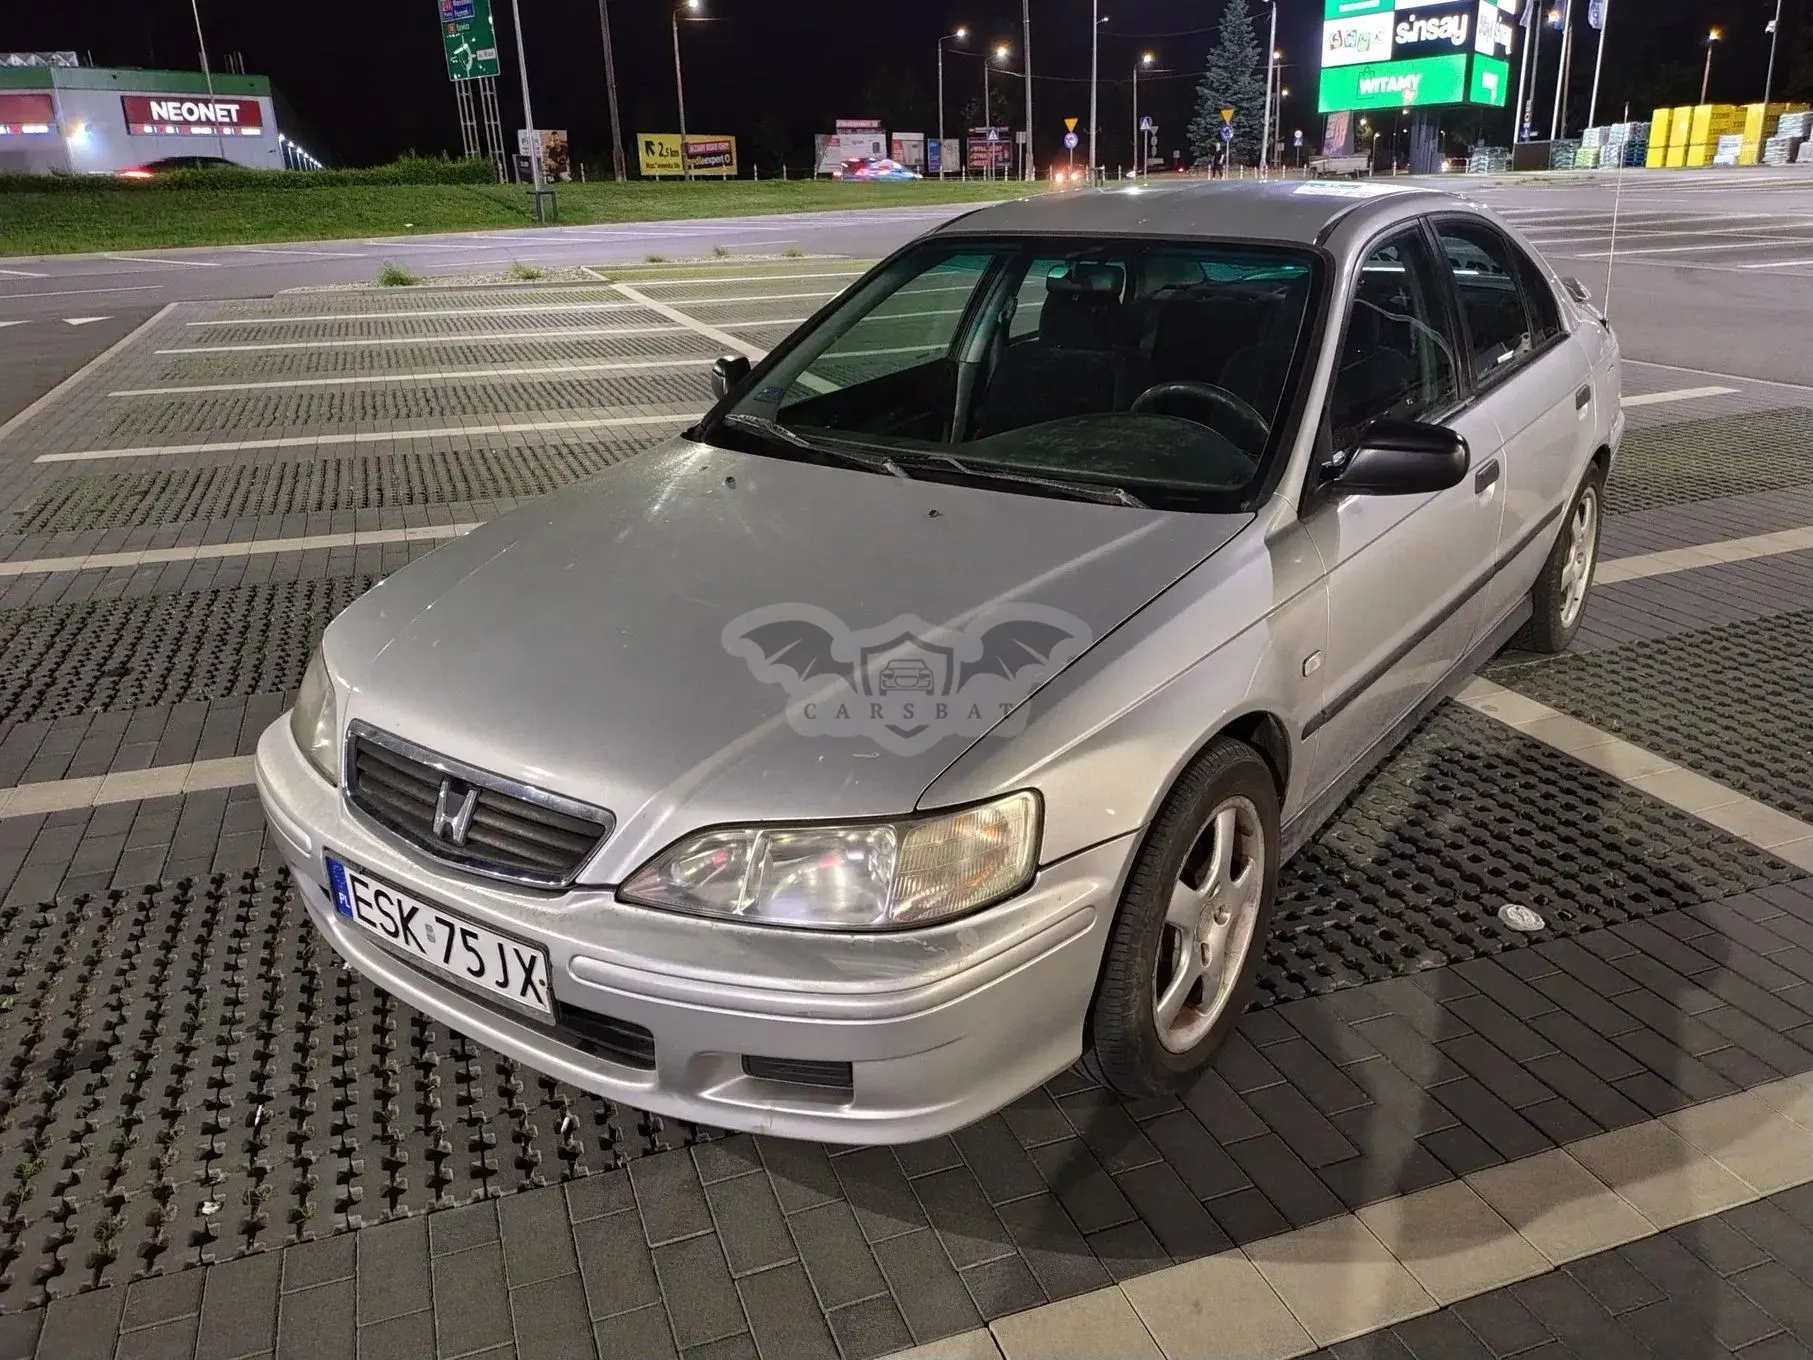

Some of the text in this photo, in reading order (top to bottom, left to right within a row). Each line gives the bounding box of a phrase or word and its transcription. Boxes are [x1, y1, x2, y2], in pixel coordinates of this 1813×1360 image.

[1395, 14, 1468, 46] sinsay
[1358, 73, 1422, 95] WITAMY
[150, 101, 240, 122] NEONET
[670, 147, 680, 157] km
[338, 892, 350, 908] PL
[349, 873, 545, 1005] ESK 75JX
